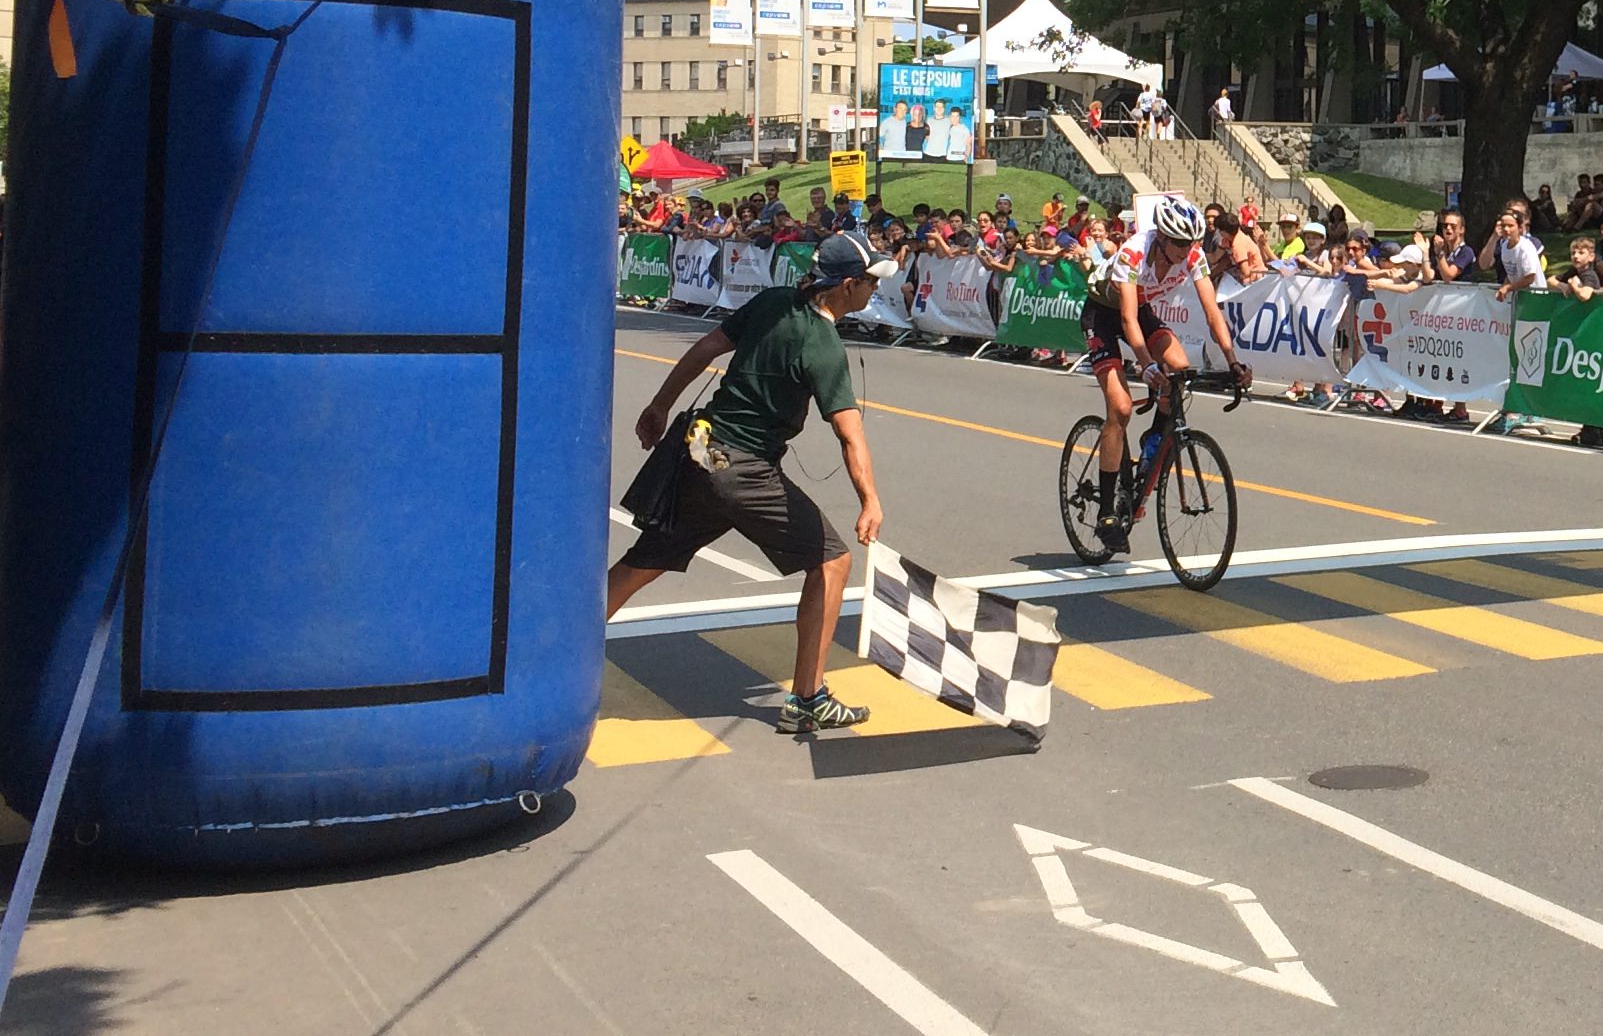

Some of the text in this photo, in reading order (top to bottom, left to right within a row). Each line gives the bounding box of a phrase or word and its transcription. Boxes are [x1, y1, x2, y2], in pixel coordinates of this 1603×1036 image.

[893, 68, 962, 88] LE CEPSUM
[1010, 286, 1082, 325] Desjardins
[1456, 316, 1486, 333] avec
